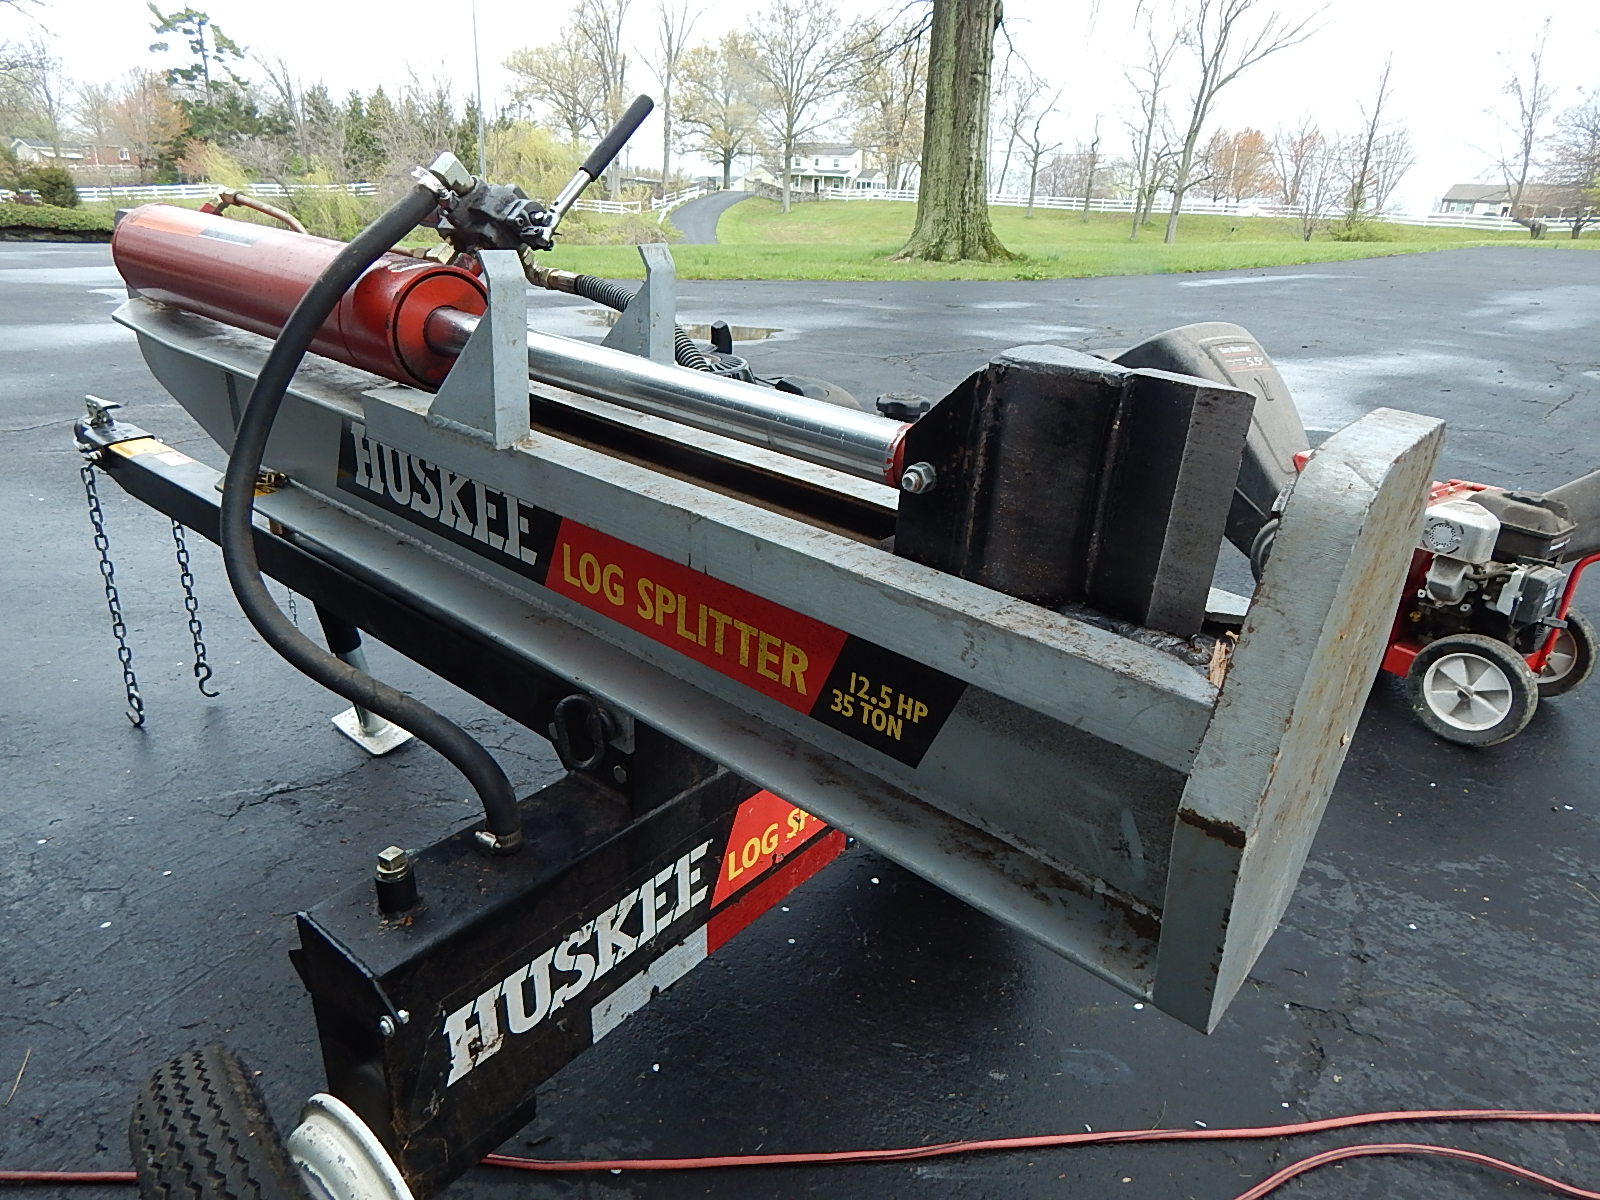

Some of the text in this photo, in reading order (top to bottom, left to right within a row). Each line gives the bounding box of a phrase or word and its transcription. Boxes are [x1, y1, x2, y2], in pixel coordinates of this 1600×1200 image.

[351, 421, 809, 695] HUSKEE LOG SPLITTER
[830, 688, 903, 741] 35 TON
[849, 672, 929, 724] 12.5 HP
[442, 807, 818, 1088] HUSKEE LOG SP
